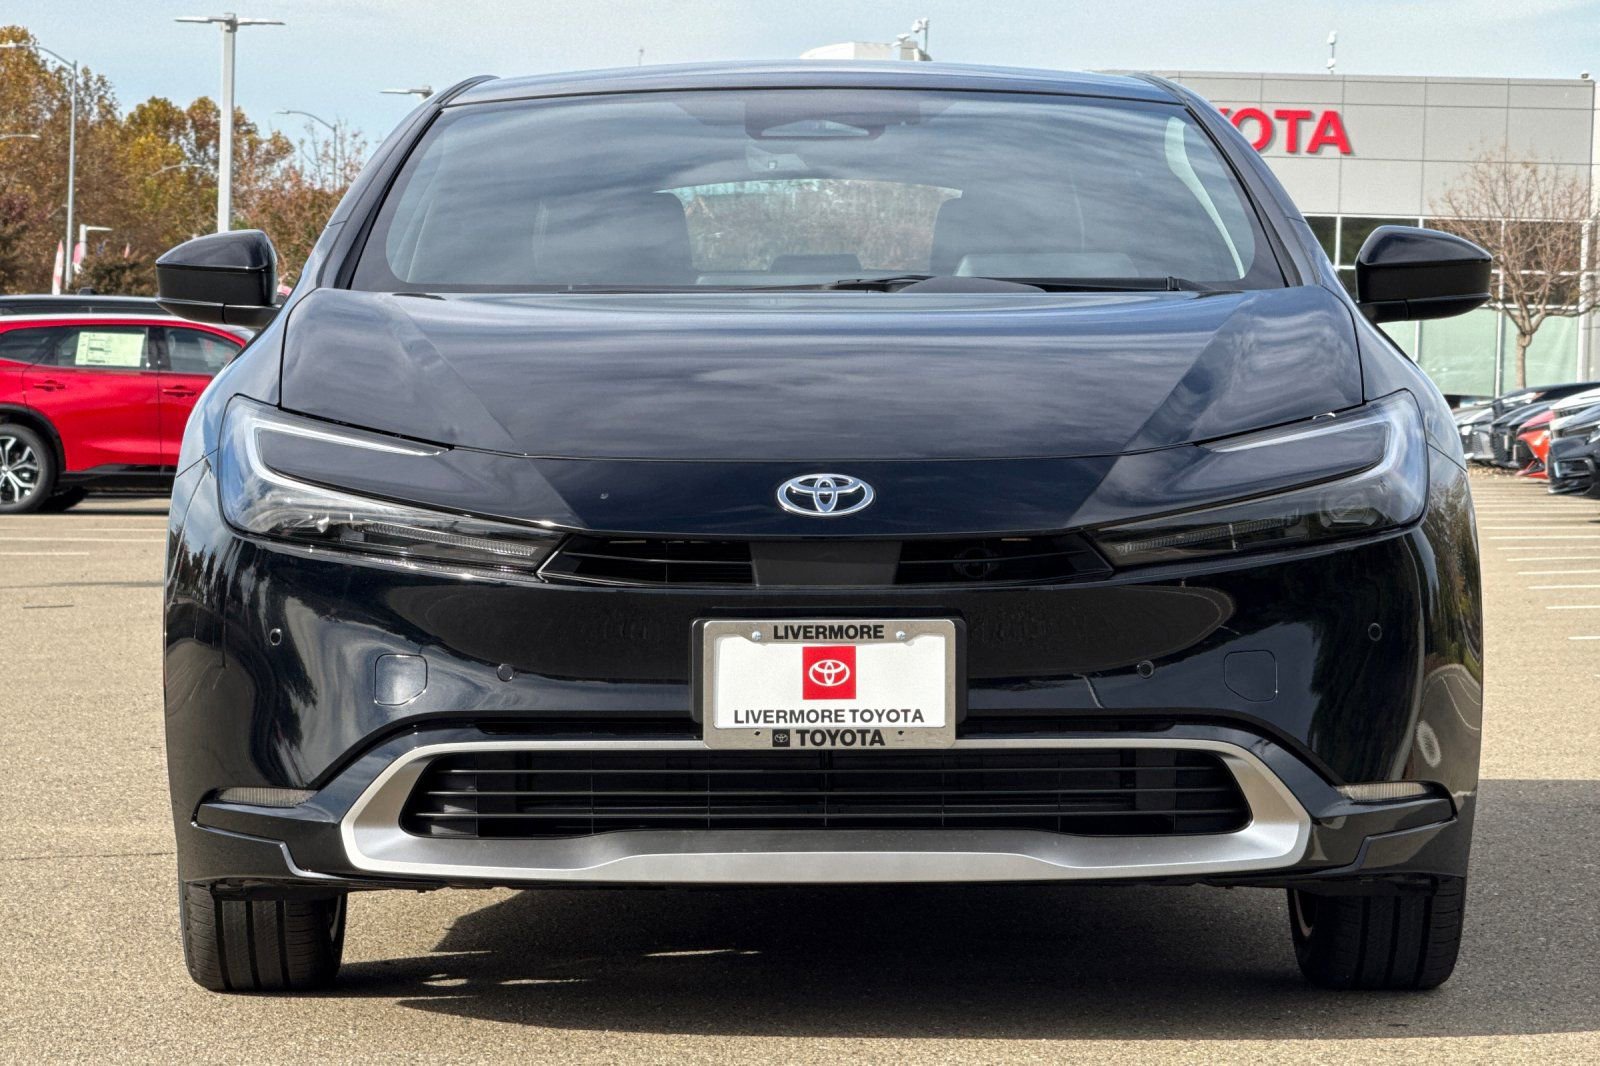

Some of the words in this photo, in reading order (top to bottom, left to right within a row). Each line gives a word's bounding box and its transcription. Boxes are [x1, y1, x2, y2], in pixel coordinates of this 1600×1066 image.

[1219, 107, 1352, 155] OTA
[773, 624, 885, 640] LIVERMORE
[734, 709, 845, 724] LIVERMORE
[849, 708, 925, 723] TOYOTA
[796, 729, 886, 747] TOYOTA
